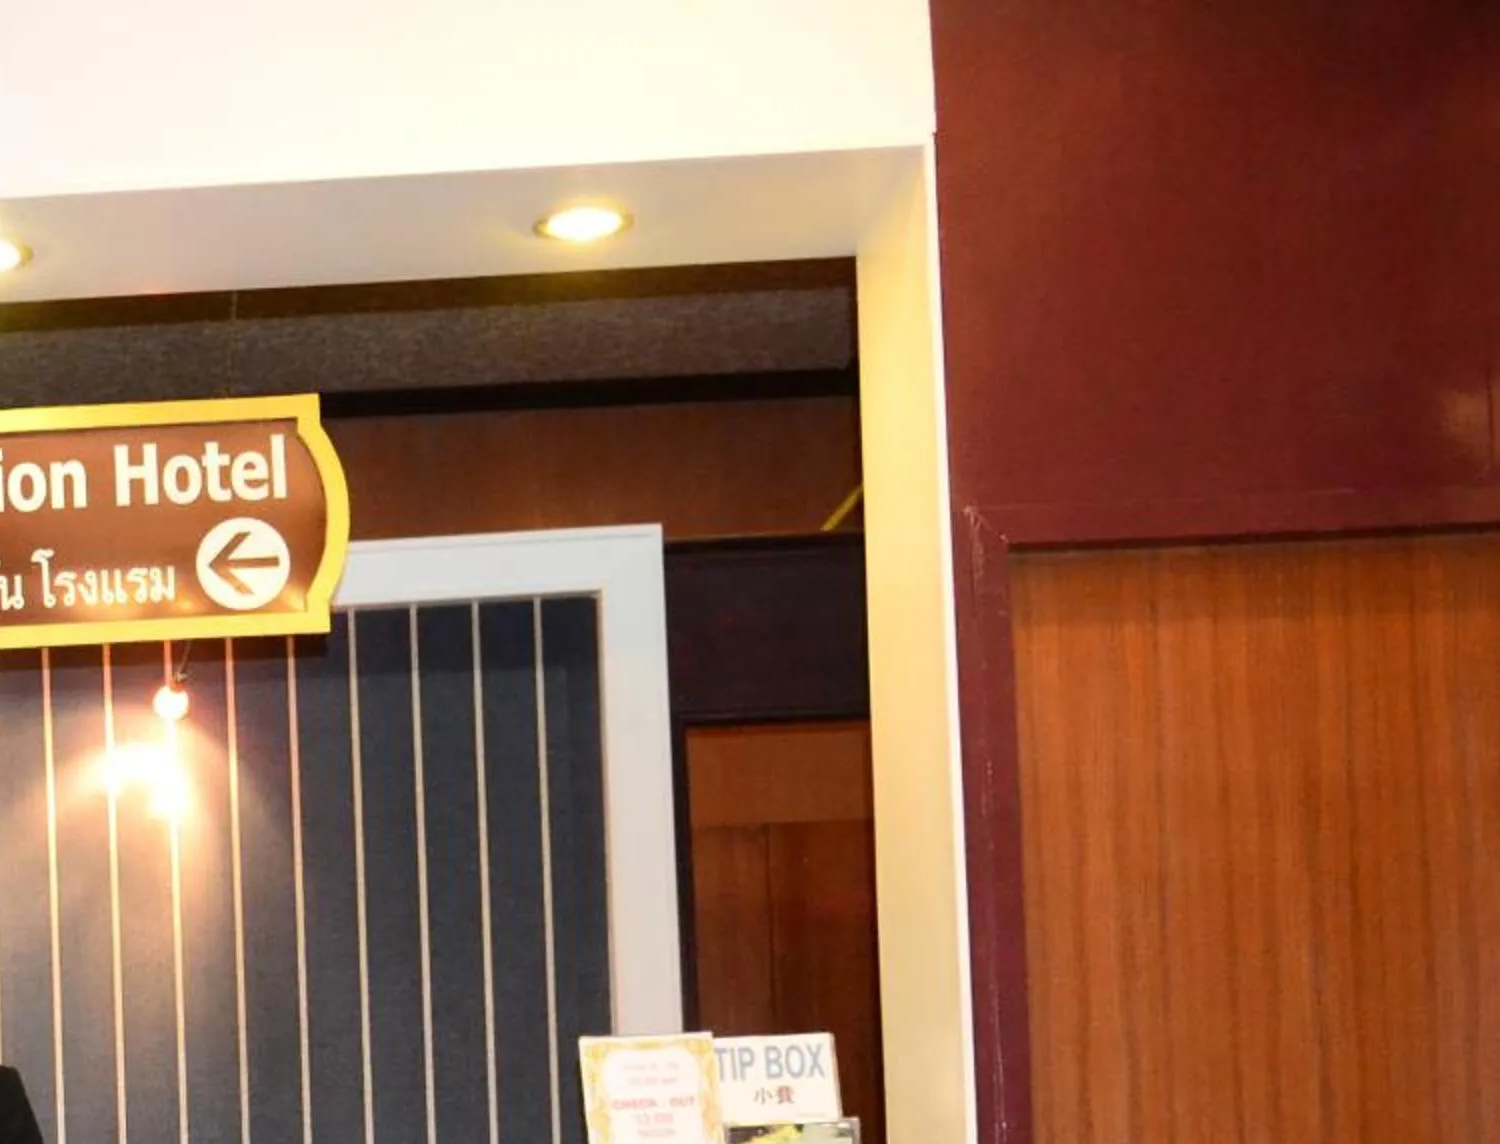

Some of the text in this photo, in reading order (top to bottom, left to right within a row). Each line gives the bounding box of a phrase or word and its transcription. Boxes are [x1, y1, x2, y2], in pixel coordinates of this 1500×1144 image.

[113, 434, 288, 507] Hotel
[31, 548, 176, 609] โรงแรม
[713, 1043, 826, 1082] TIP BOX
[753, 1085, 795, 1106] 小費
